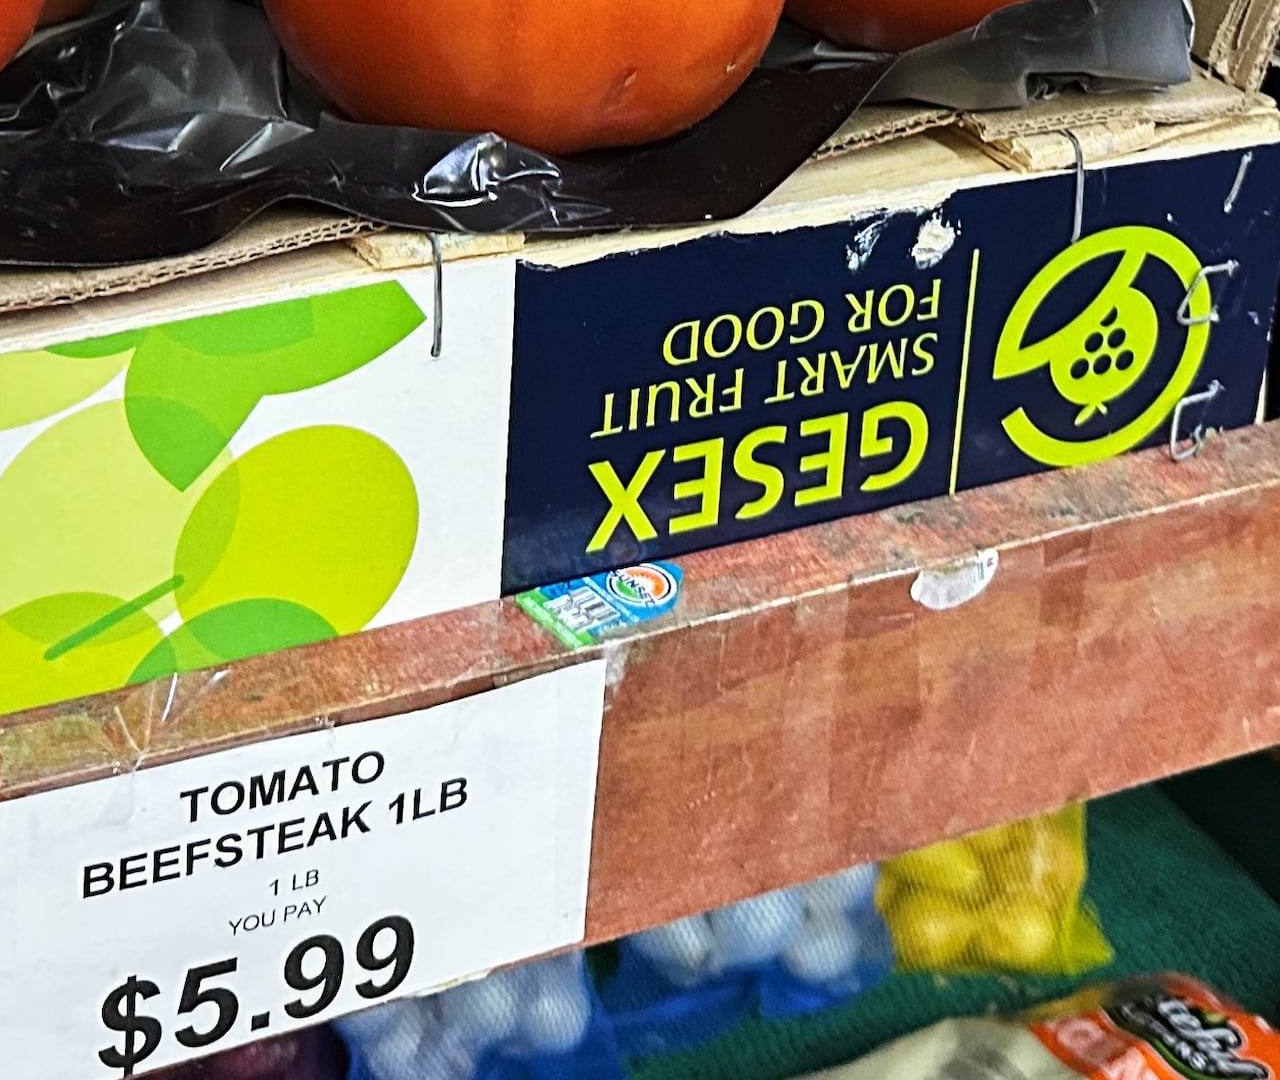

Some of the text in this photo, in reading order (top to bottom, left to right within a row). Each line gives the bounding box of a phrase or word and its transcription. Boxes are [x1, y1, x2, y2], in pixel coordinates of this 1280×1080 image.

[662, 278, 942, 367] FOR GOOD
[590, 331, 938, 438] SMART FRUIT
[586, 399, 929, 554] GESEX
[179, 750, 386, 824] TOMATO
[82, 776, 469, 900] BEEFSTEAK 1LB
[268, 868, 320, 897] 1 LB
[227, 895, 328, 937] YOU PAY
[98, 915, 418, 1078] $5.99
